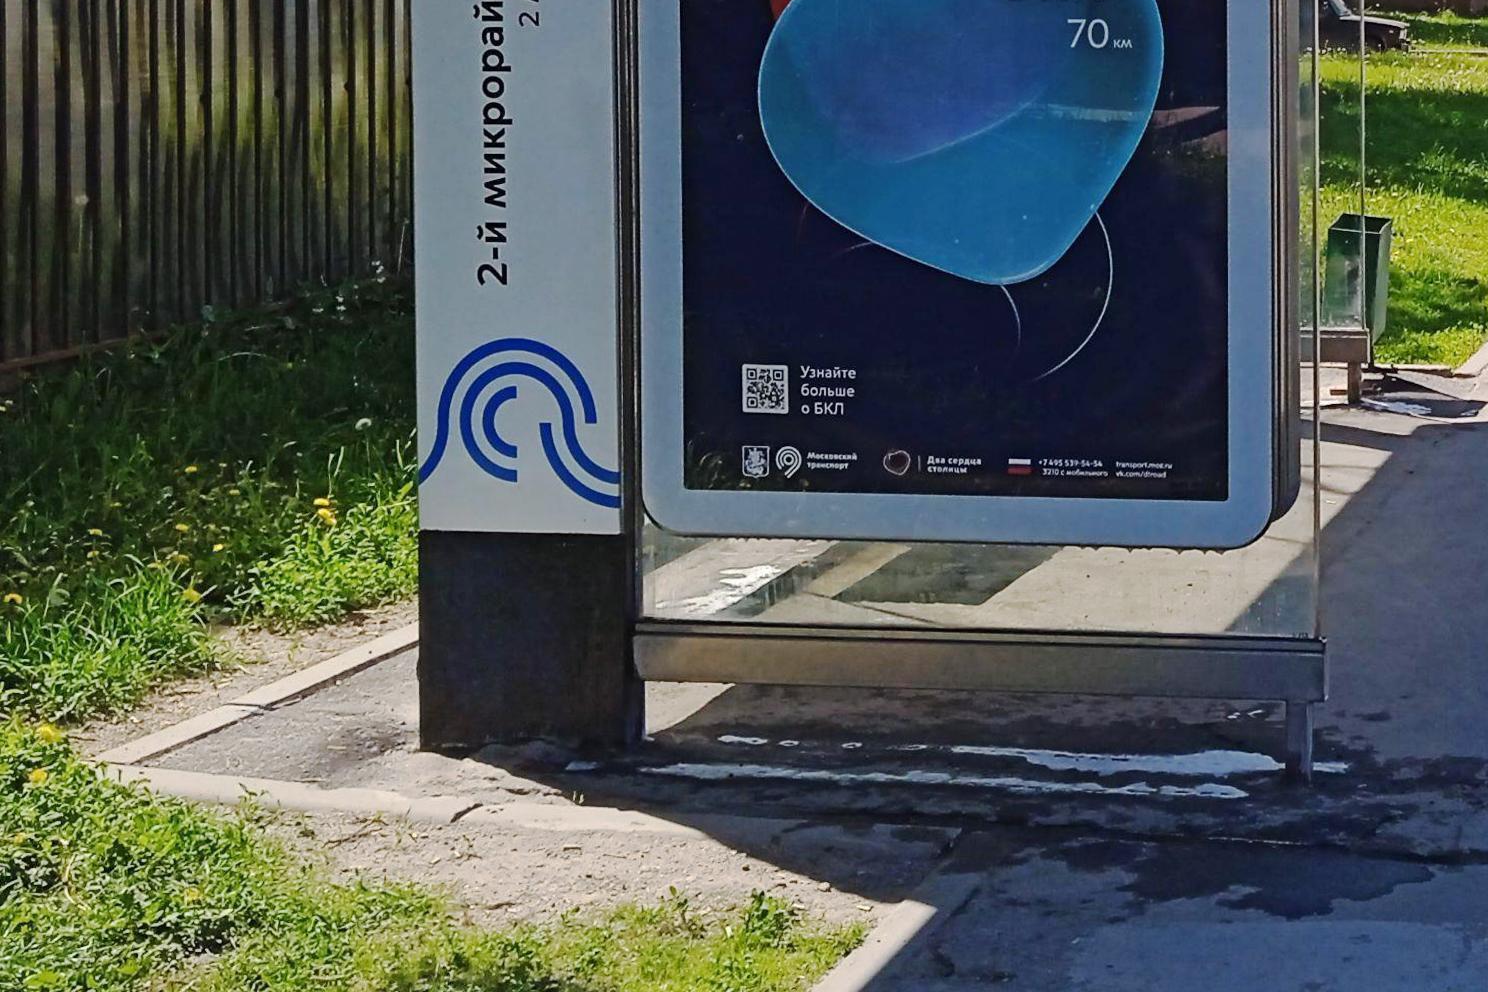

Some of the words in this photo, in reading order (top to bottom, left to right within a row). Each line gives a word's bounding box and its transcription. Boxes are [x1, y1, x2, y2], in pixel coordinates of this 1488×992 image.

[518, 10, 541, 28] 2
[1067, 18, 1109, 49] 70
[1113, 39, 1133, 48] км
[475, 221, 508, 287] 2-й
[800, 365, 857, 380] Узнайте
[800, 383, 855, 398] больше
[800, 404, 810, 415] о
[814, 401, 844, 416] БКЛ
[806, 451, 858, 461] Московский
[926, 455, 946, 465] Два
[947, 457, 982, 467] сердца
[806, 461, 849, 470] транспорт
[926, 465, 968, 474] столицы
